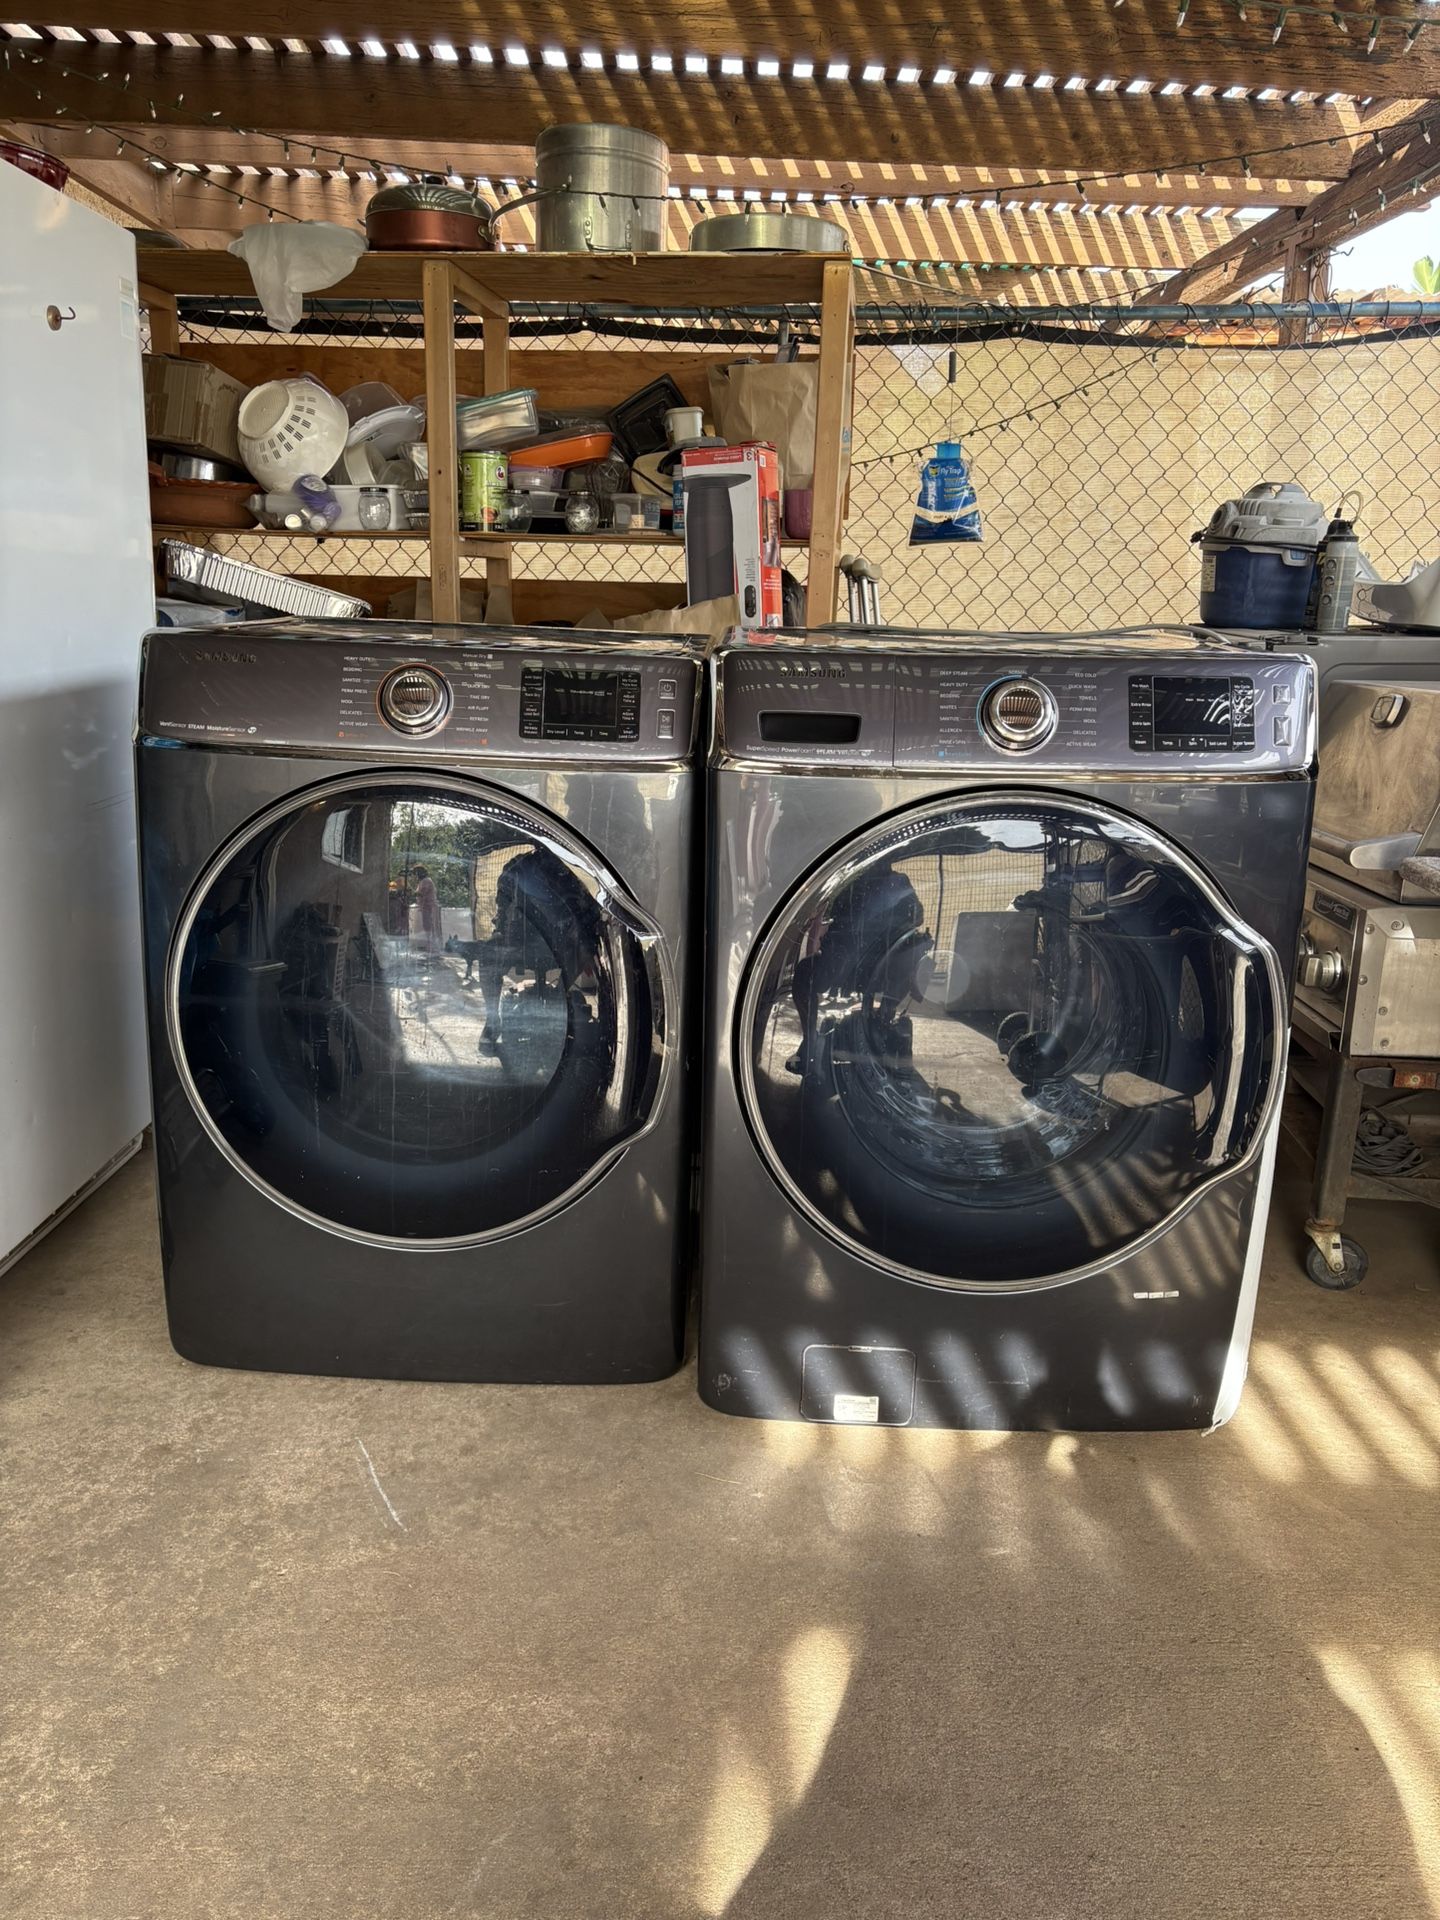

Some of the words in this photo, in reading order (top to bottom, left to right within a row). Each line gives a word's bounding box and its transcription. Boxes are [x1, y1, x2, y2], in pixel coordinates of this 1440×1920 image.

[746, 452, 752, 461] 3
[940, 468, 948, 476] Fly
[949, 467, 962, 475] Trap
[780, 667, 846, 678] SAMSUNG
